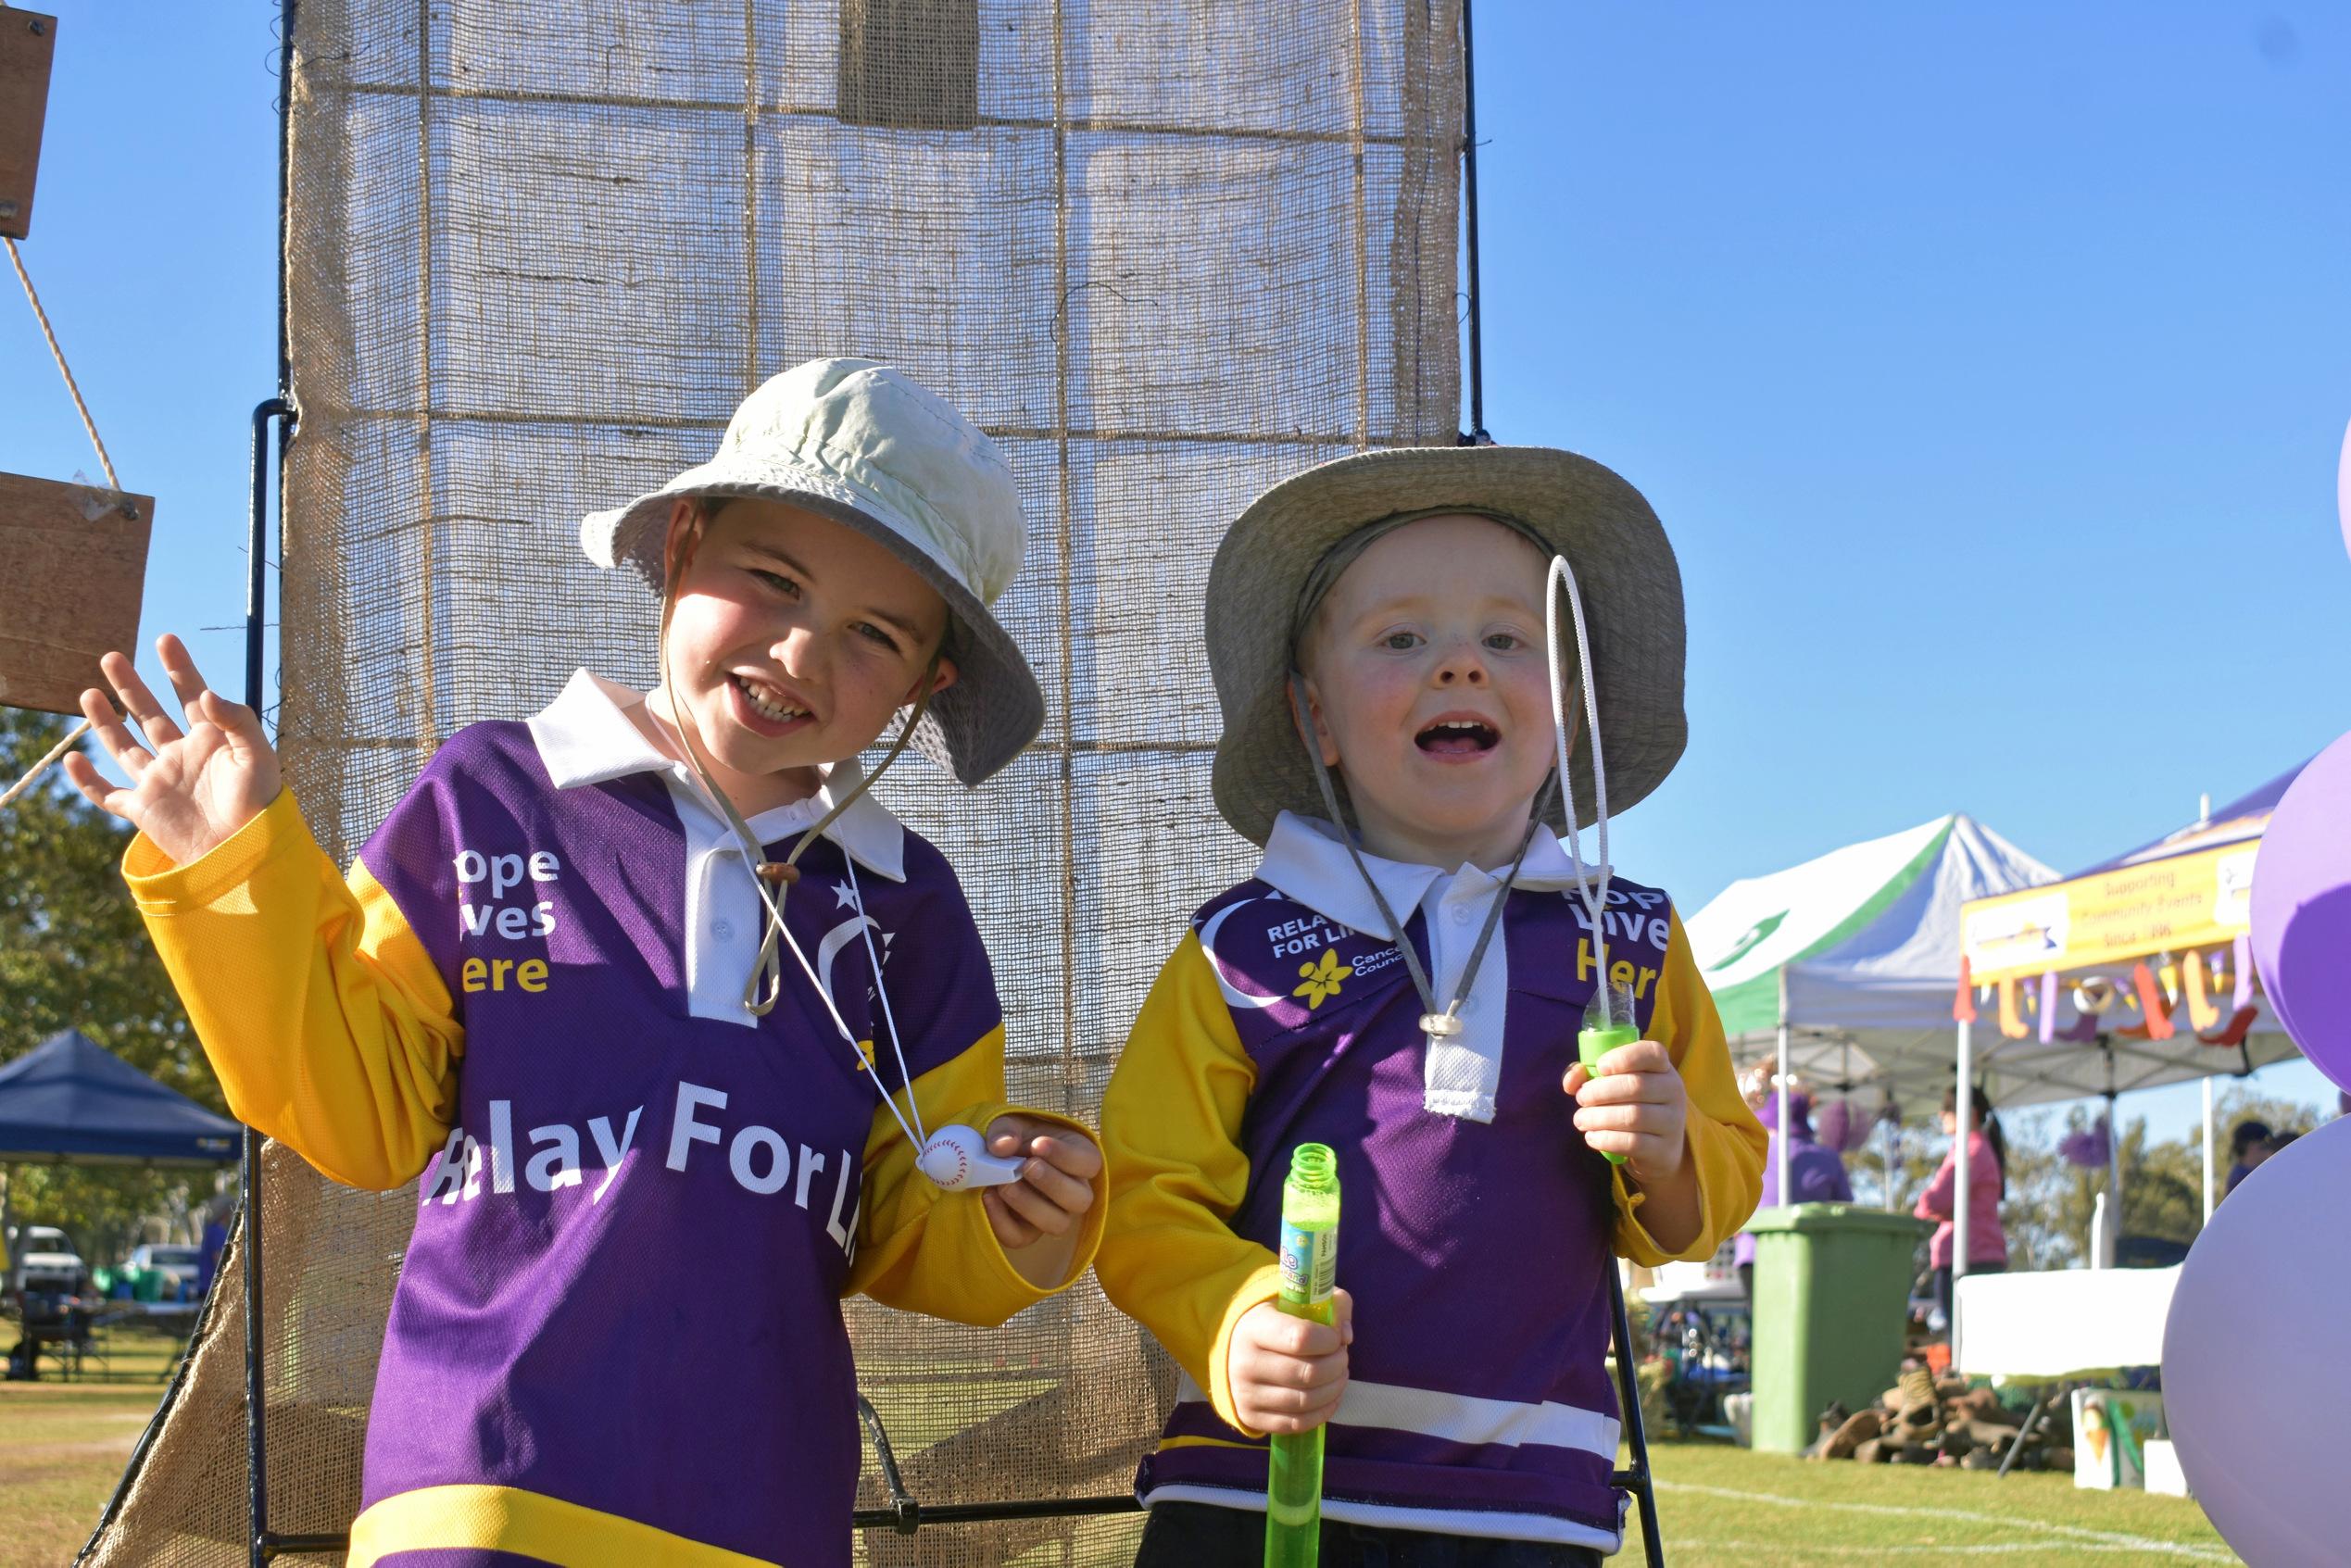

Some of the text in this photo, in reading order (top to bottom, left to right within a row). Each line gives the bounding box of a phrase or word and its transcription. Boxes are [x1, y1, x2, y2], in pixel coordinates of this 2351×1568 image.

[452, 849, 559, 899] ope
[2105, 872, 2176, 898] Supporting
[459, 901, 557, 942] ves
[1266, 914, 1328, 943] RELA
[1567, 903, 1670, 952] Live
[1272, 923, 1355, 959] FOR LI
[1352, 947, 1401, 967] Canc
[462, 957, 549, 993] ere
[1354, 953, 1405, 977] Counc
[1577, 937, 1658, 1000] Her
[421, 1098, 645, 1207] Relay
[665, 1080, 825, 1210] For
